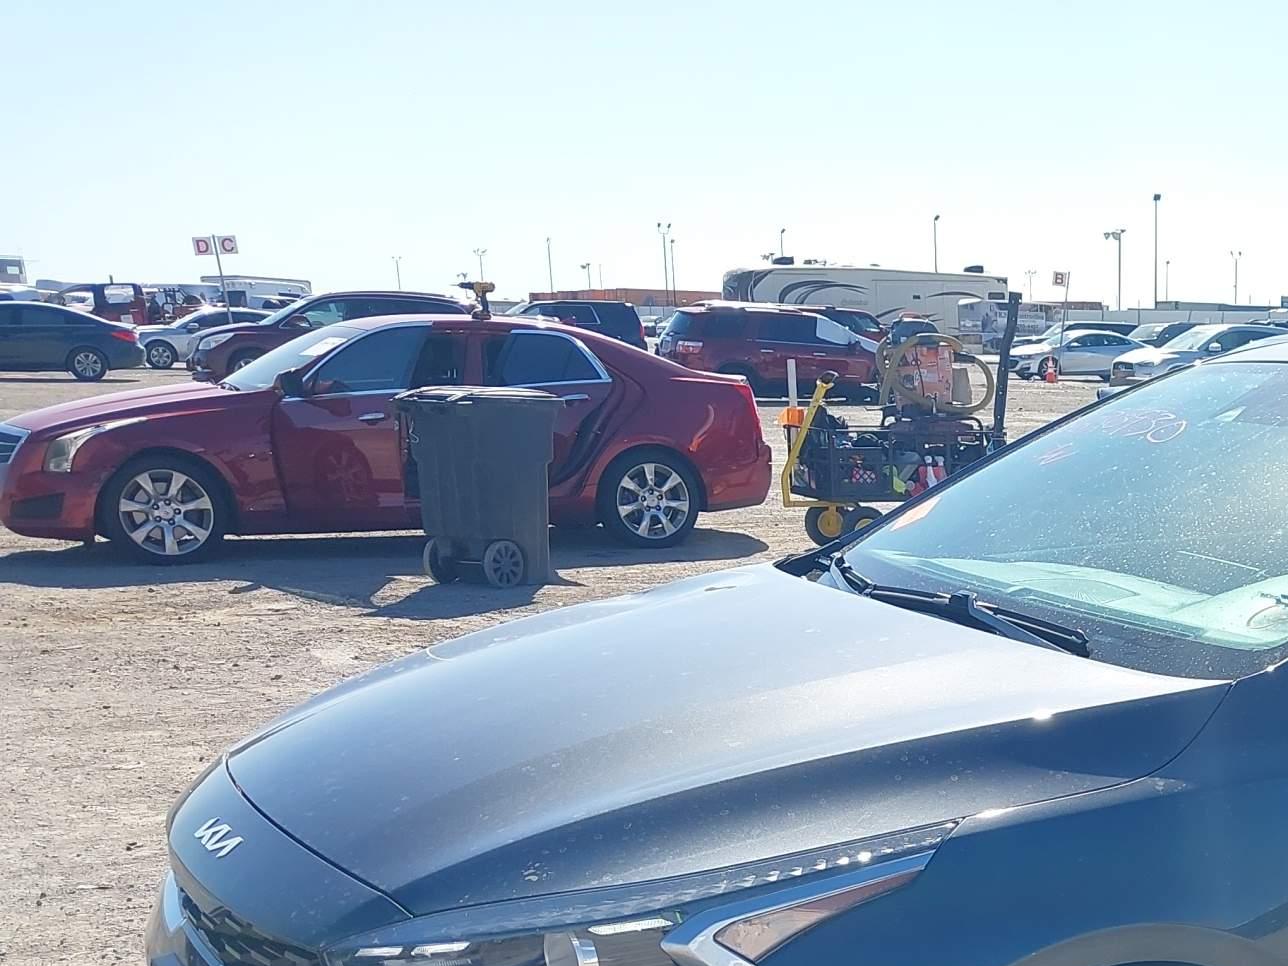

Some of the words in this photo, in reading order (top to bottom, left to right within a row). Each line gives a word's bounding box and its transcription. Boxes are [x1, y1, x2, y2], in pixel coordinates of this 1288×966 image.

[195, 240, 209, 253] D
[222, 238, 234, 252] C
[194, 817, 244, 857] KIA
